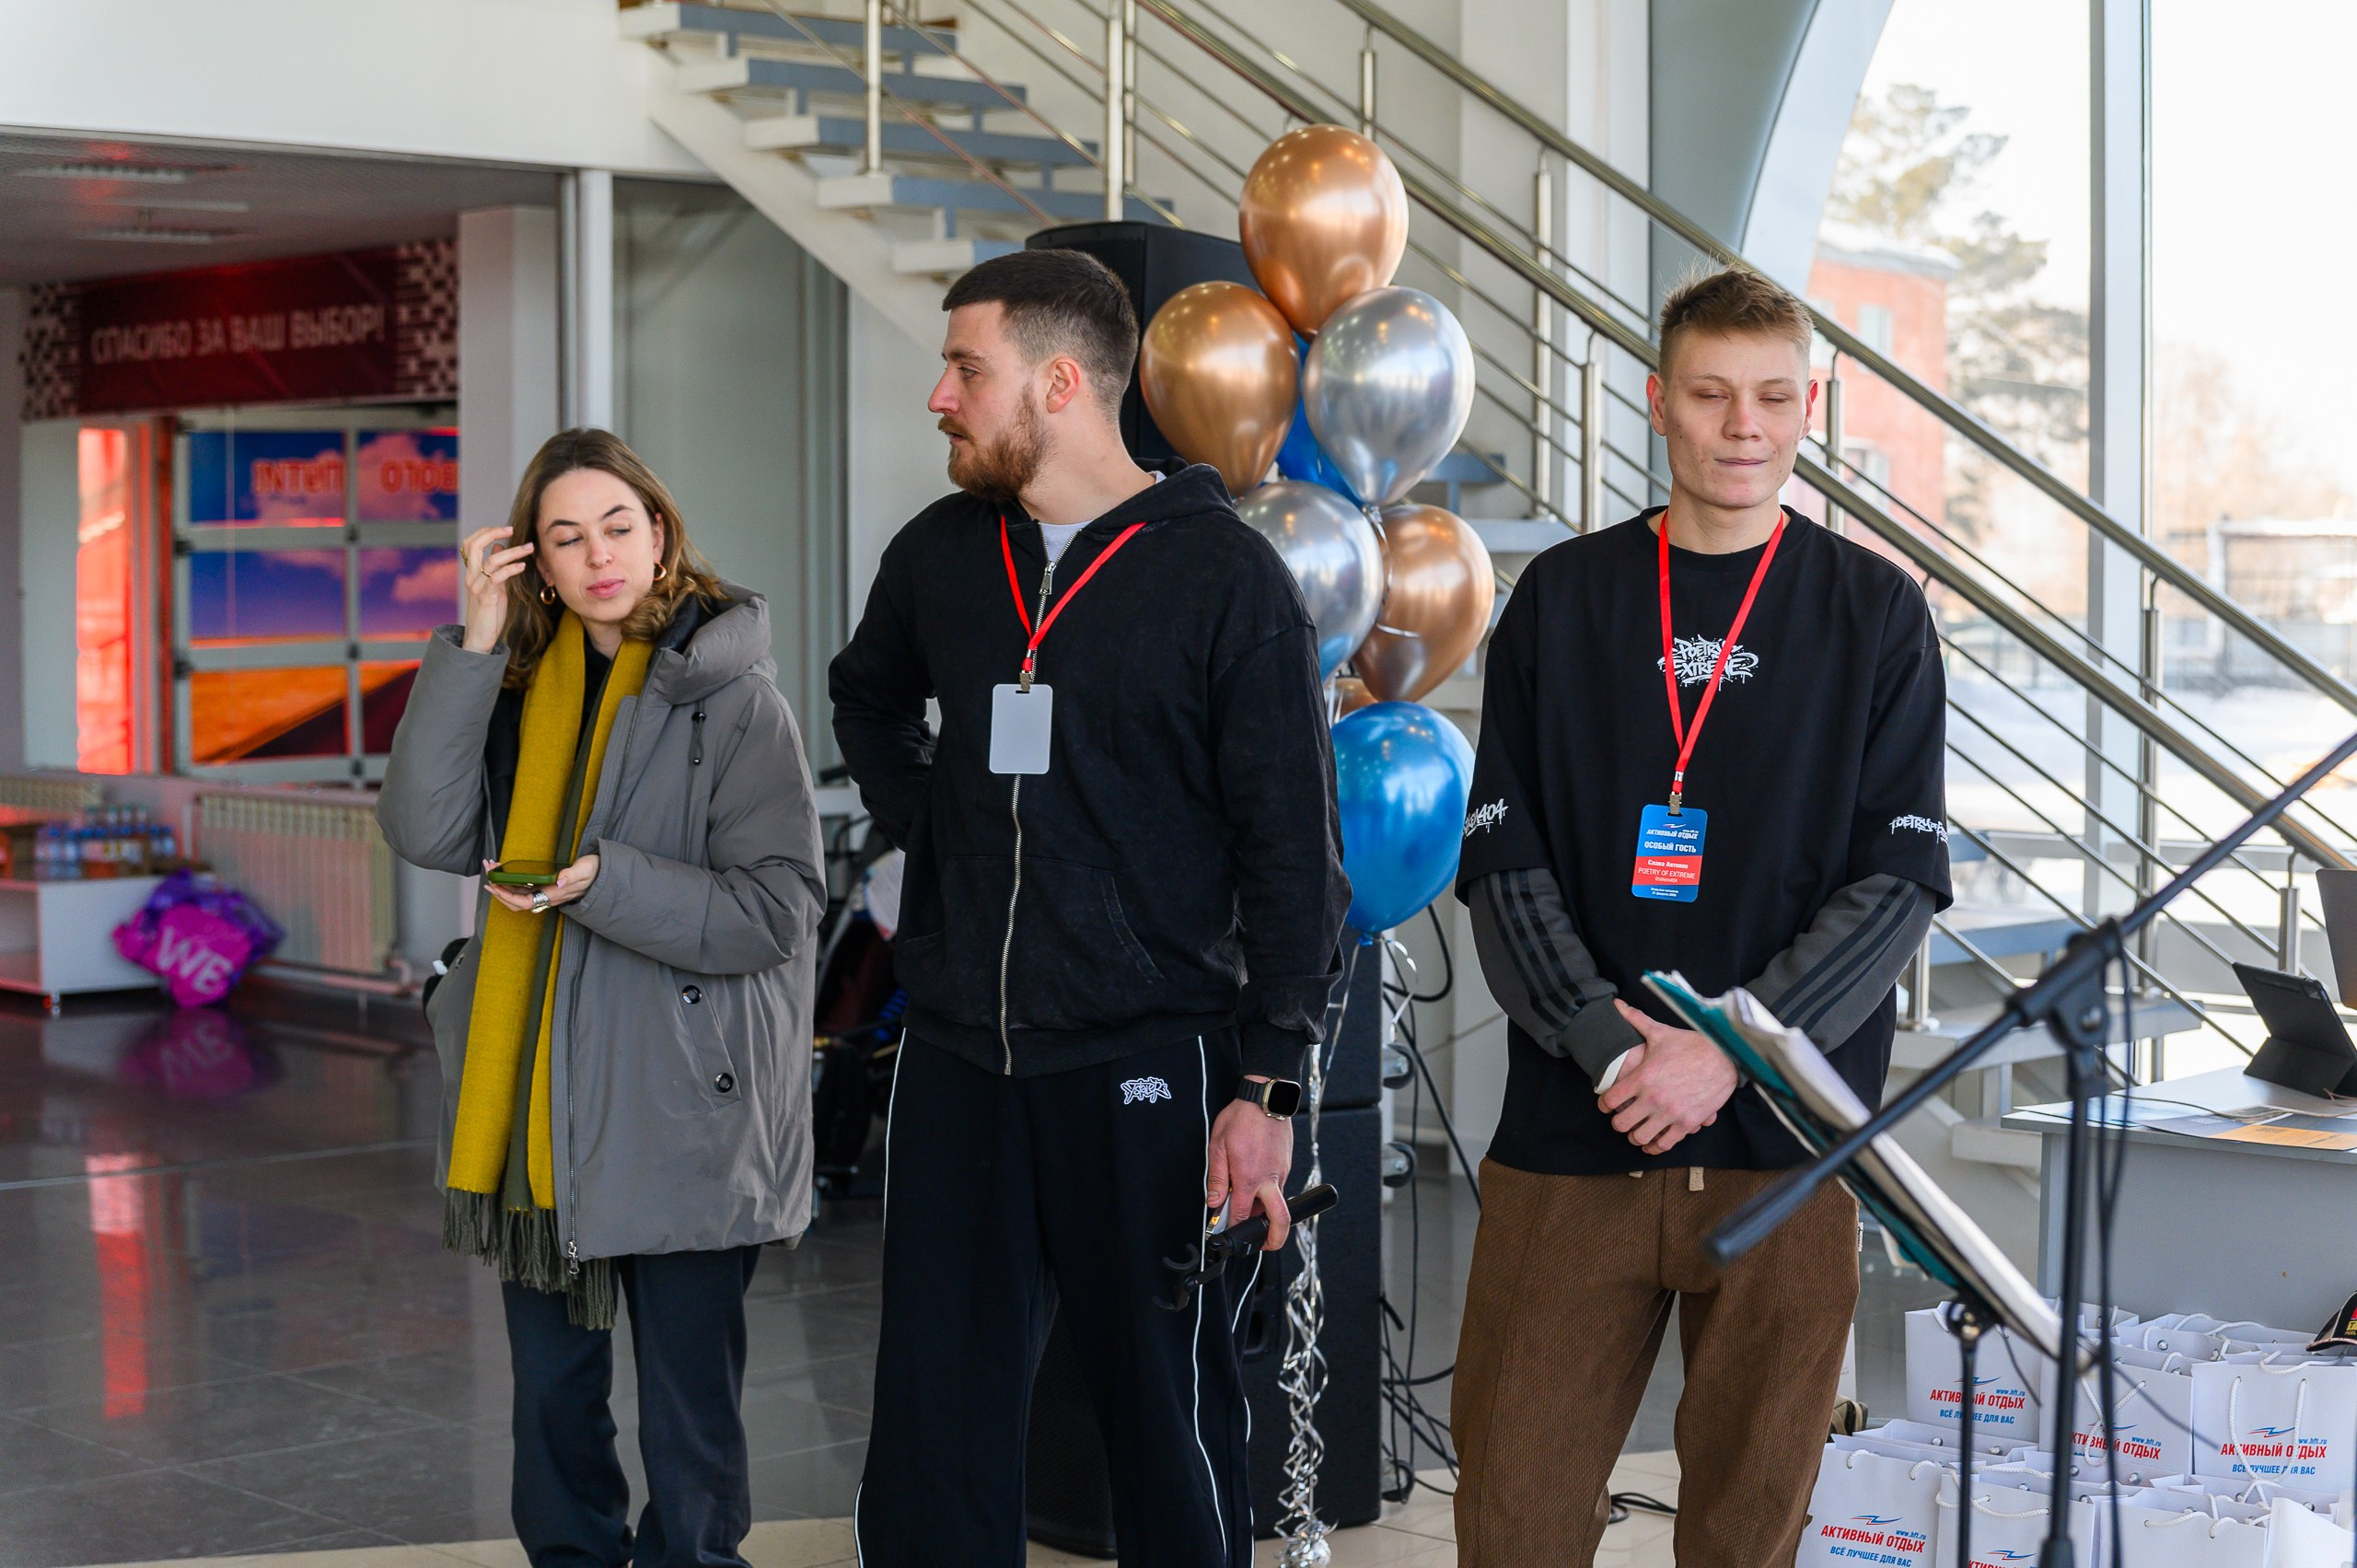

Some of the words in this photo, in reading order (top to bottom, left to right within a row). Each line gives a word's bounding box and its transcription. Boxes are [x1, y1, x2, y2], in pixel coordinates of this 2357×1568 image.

[93, 319, 192, 366] СПАСИБО
[196, 318, 226, 357] ЗА
[230, 312, 285, 354] ВАШ
[289, 304, 386, 350] ВЫБОР!
[1646, 829, 1678, 838] АКТИВНЫЙ
[1678, 831, 1699, 840] ОТДЫХ
[1644, 841, 1674, 851] ОСОБЫЙ
[1675, 843, 1697, 853] ГОСТЬ
[1638, 867, 1661, 876] POETRY
[1669, 870, 1696, 879] EXTREME
[157, 923, 235, 995] WE
[1930, 1389, 1986, 1405] АКТИВЫЙ
[1988, 1394, 2026, 1410] ОТДЫХ
[1996, 1388, 2026, 1397] www.hft.ru
[1940, 1409, 1953, 1418] ВСЁ
[1983, 1413, 1999, 1423] ДЛЯ
[2000, 1416, 2014, 1424] ВАС
[2131, 1436, 2162, 1446] www.hft.ru
[2122, 1442, 2162, 1459] ОТДЫХ
[2220, 1442, 2283, 1458] АКИВНЫЙ
[2285, 1445, 2328, 1459] ОДЫХ
[2300, 1467, 2316, 1475] ВАС
[1820, 1525, 1885, 1545] АКТИВНЫЙ
[1886, 1535, 1926, 1553] ОТДЫХ
[1896, 1529, 1927, 1540] www.hft.ru
[1830, 1546, 1847, 1556] ВСЁ
[1846, 1549, 1879, 1562] ЛУЧШЕЕ
[1879, 1554, 1897, 1564] ДЛЯ
[1897, 1558, 1912, 1567] ВАС
